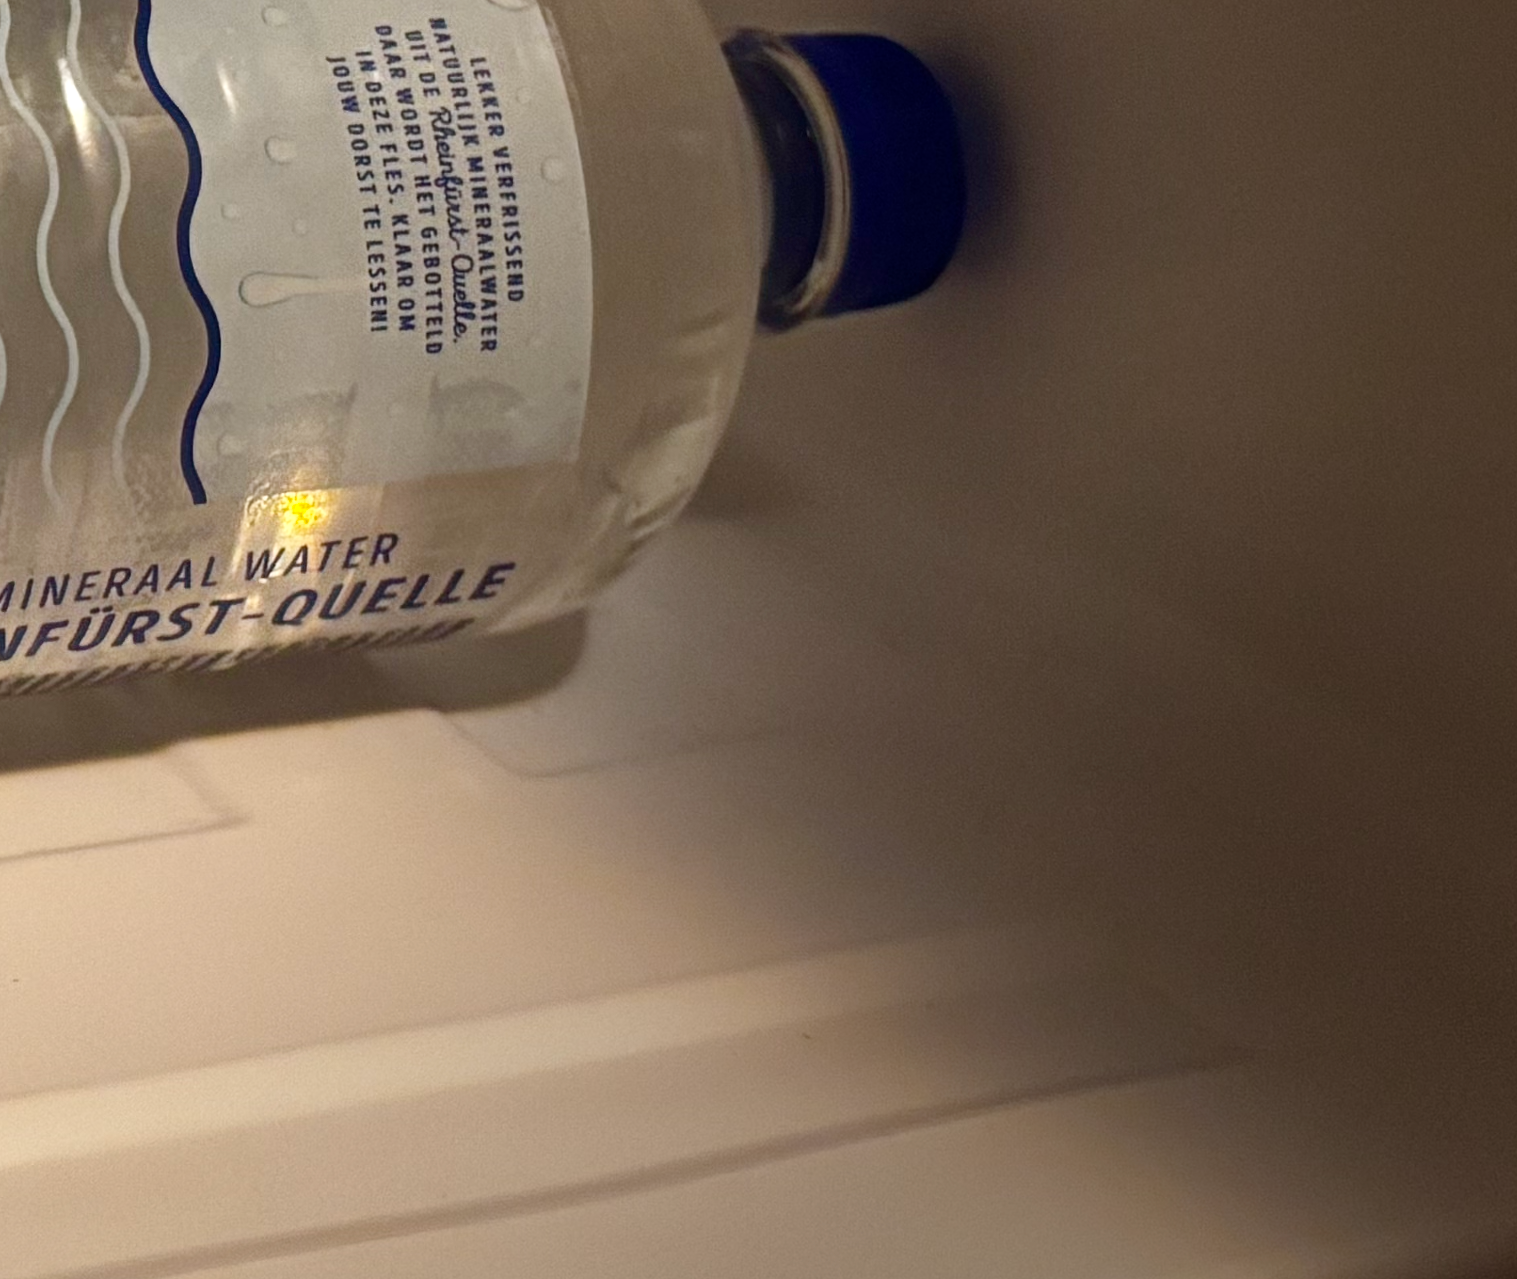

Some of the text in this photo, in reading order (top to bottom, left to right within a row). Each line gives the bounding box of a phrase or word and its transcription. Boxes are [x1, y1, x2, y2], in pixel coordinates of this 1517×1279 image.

[326, 56, 388, 333] JOUW DORST TE LESSEN!
[356, 50, 416, 333] IN DEZE FLES. KLAAR OM
[375, 25, 443, 355] DAAR WORDT HET GEBOTTELD
[405, 30, 429, 65] UIT
[419, 72, 441, 99] DE
[429, 17, 497, 353] NATUURLIJK MINERAALWATER
[470, 57, 524, 303] LEKKER VERFRISSEND
[243, 531, 400, 583] WATER
